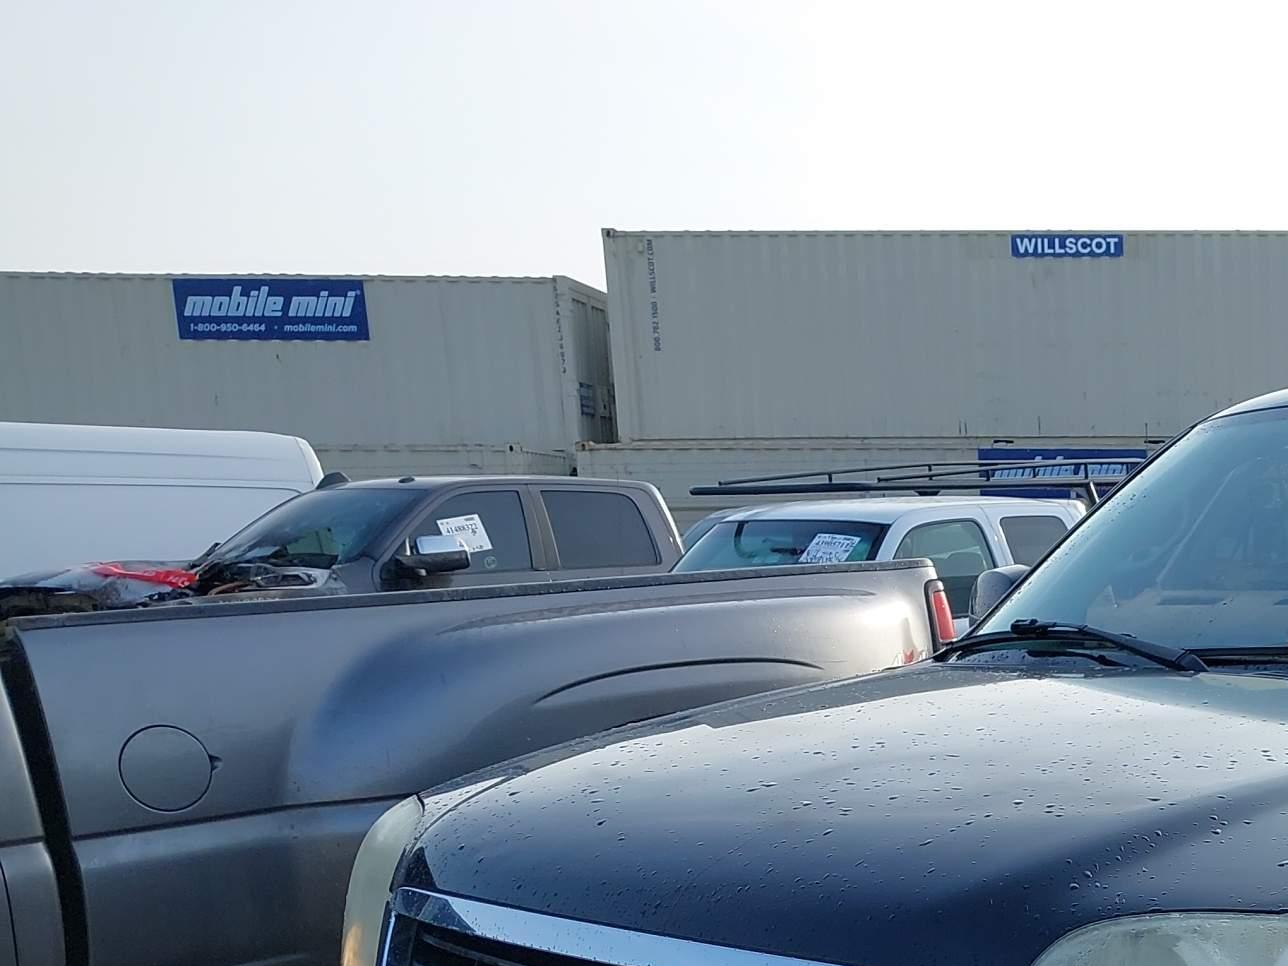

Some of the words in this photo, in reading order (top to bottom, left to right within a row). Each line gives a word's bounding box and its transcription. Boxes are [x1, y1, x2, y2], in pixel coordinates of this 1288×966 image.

[1016, 237, 1119, 254] WILLSCOT
[183, 286, 284, 317] mobile
[288, 290, 356, 317] mini
[189, 322, 266, 333] 1-800-950-6464
[283, 323, 358, 333] mobilemini.com
